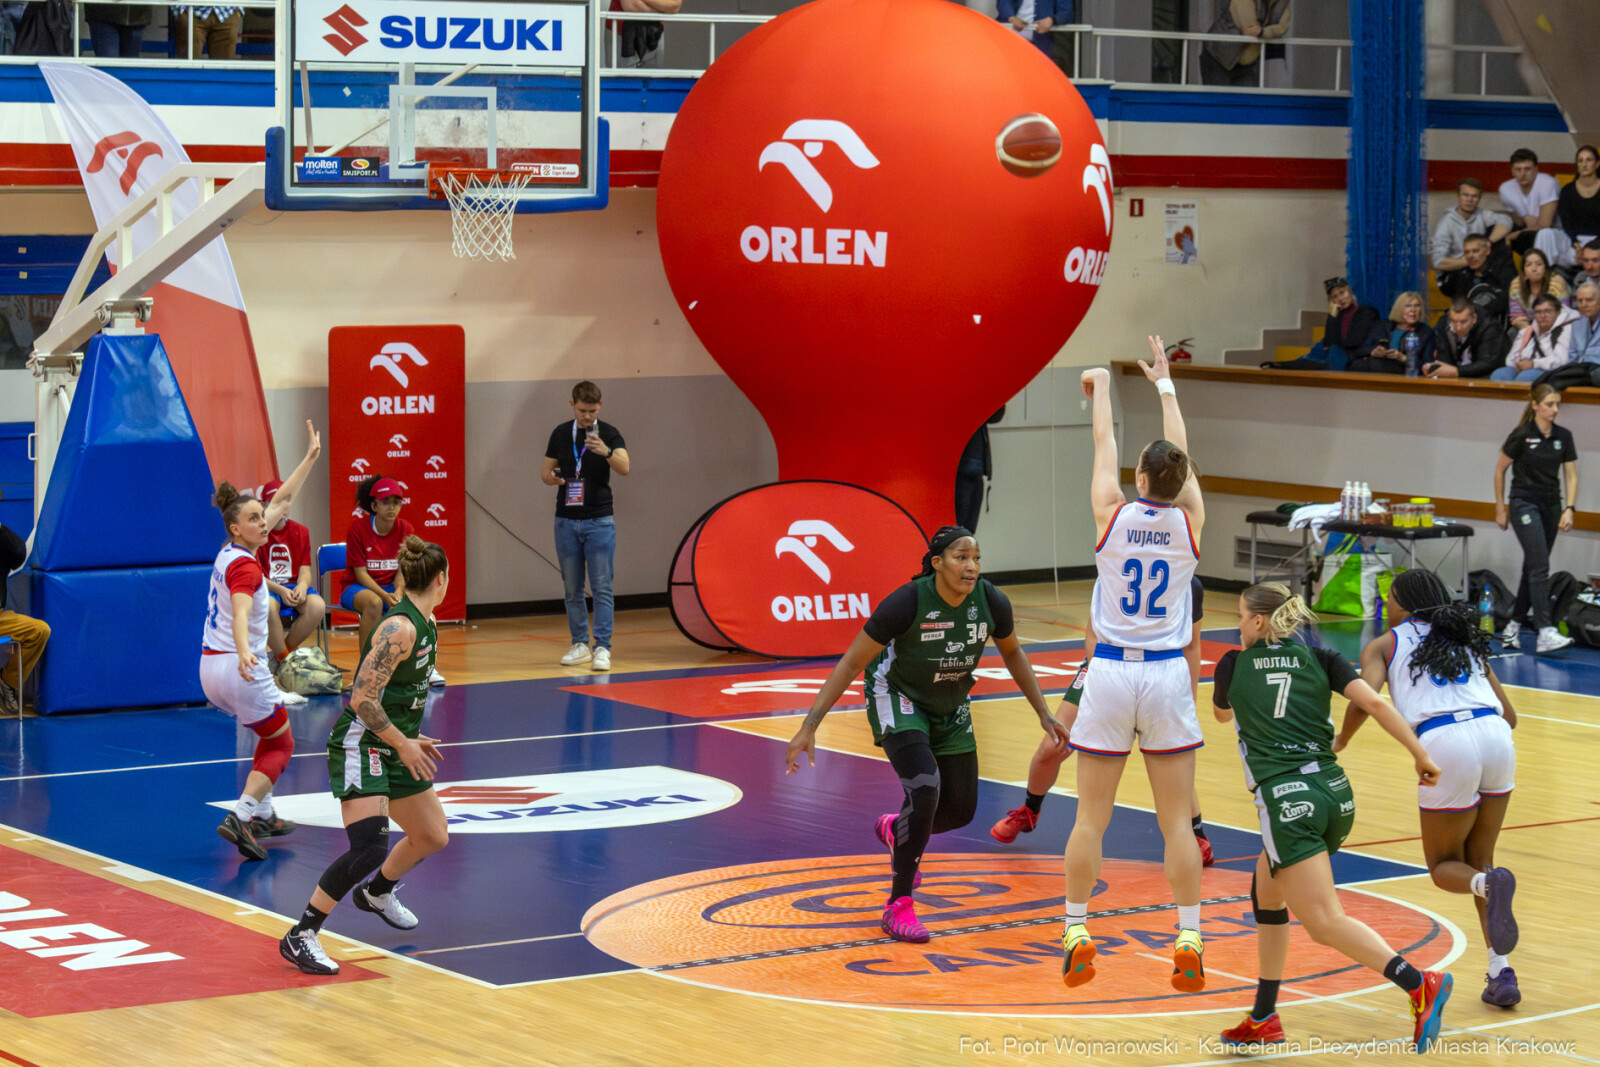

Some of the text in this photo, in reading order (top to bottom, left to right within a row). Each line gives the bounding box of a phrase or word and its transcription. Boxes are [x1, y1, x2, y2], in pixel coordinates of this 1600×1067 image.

[380, 15, 563, 51] SUZUKI
[305, 160, 338, 169] molten
[740, 225, 888, 268] ORLEN
[361, 395, 435, 415] ORLEN
[387, 450, 410, 458] ORLEN
[1127, 529, 1171, 548] VUJACIC
[1120, 558, 1170, 618] 32
[771, 593, 871, 622] ORLEN
[966, 622, 988, 645] 34
[1253, 656, 1300, 670] WOJTALA
[1266, 672, 1292, 719] 7
[1277, 783, 1305, 795] PERŁA
[1285, 804, 1309, 818] LOTTO
